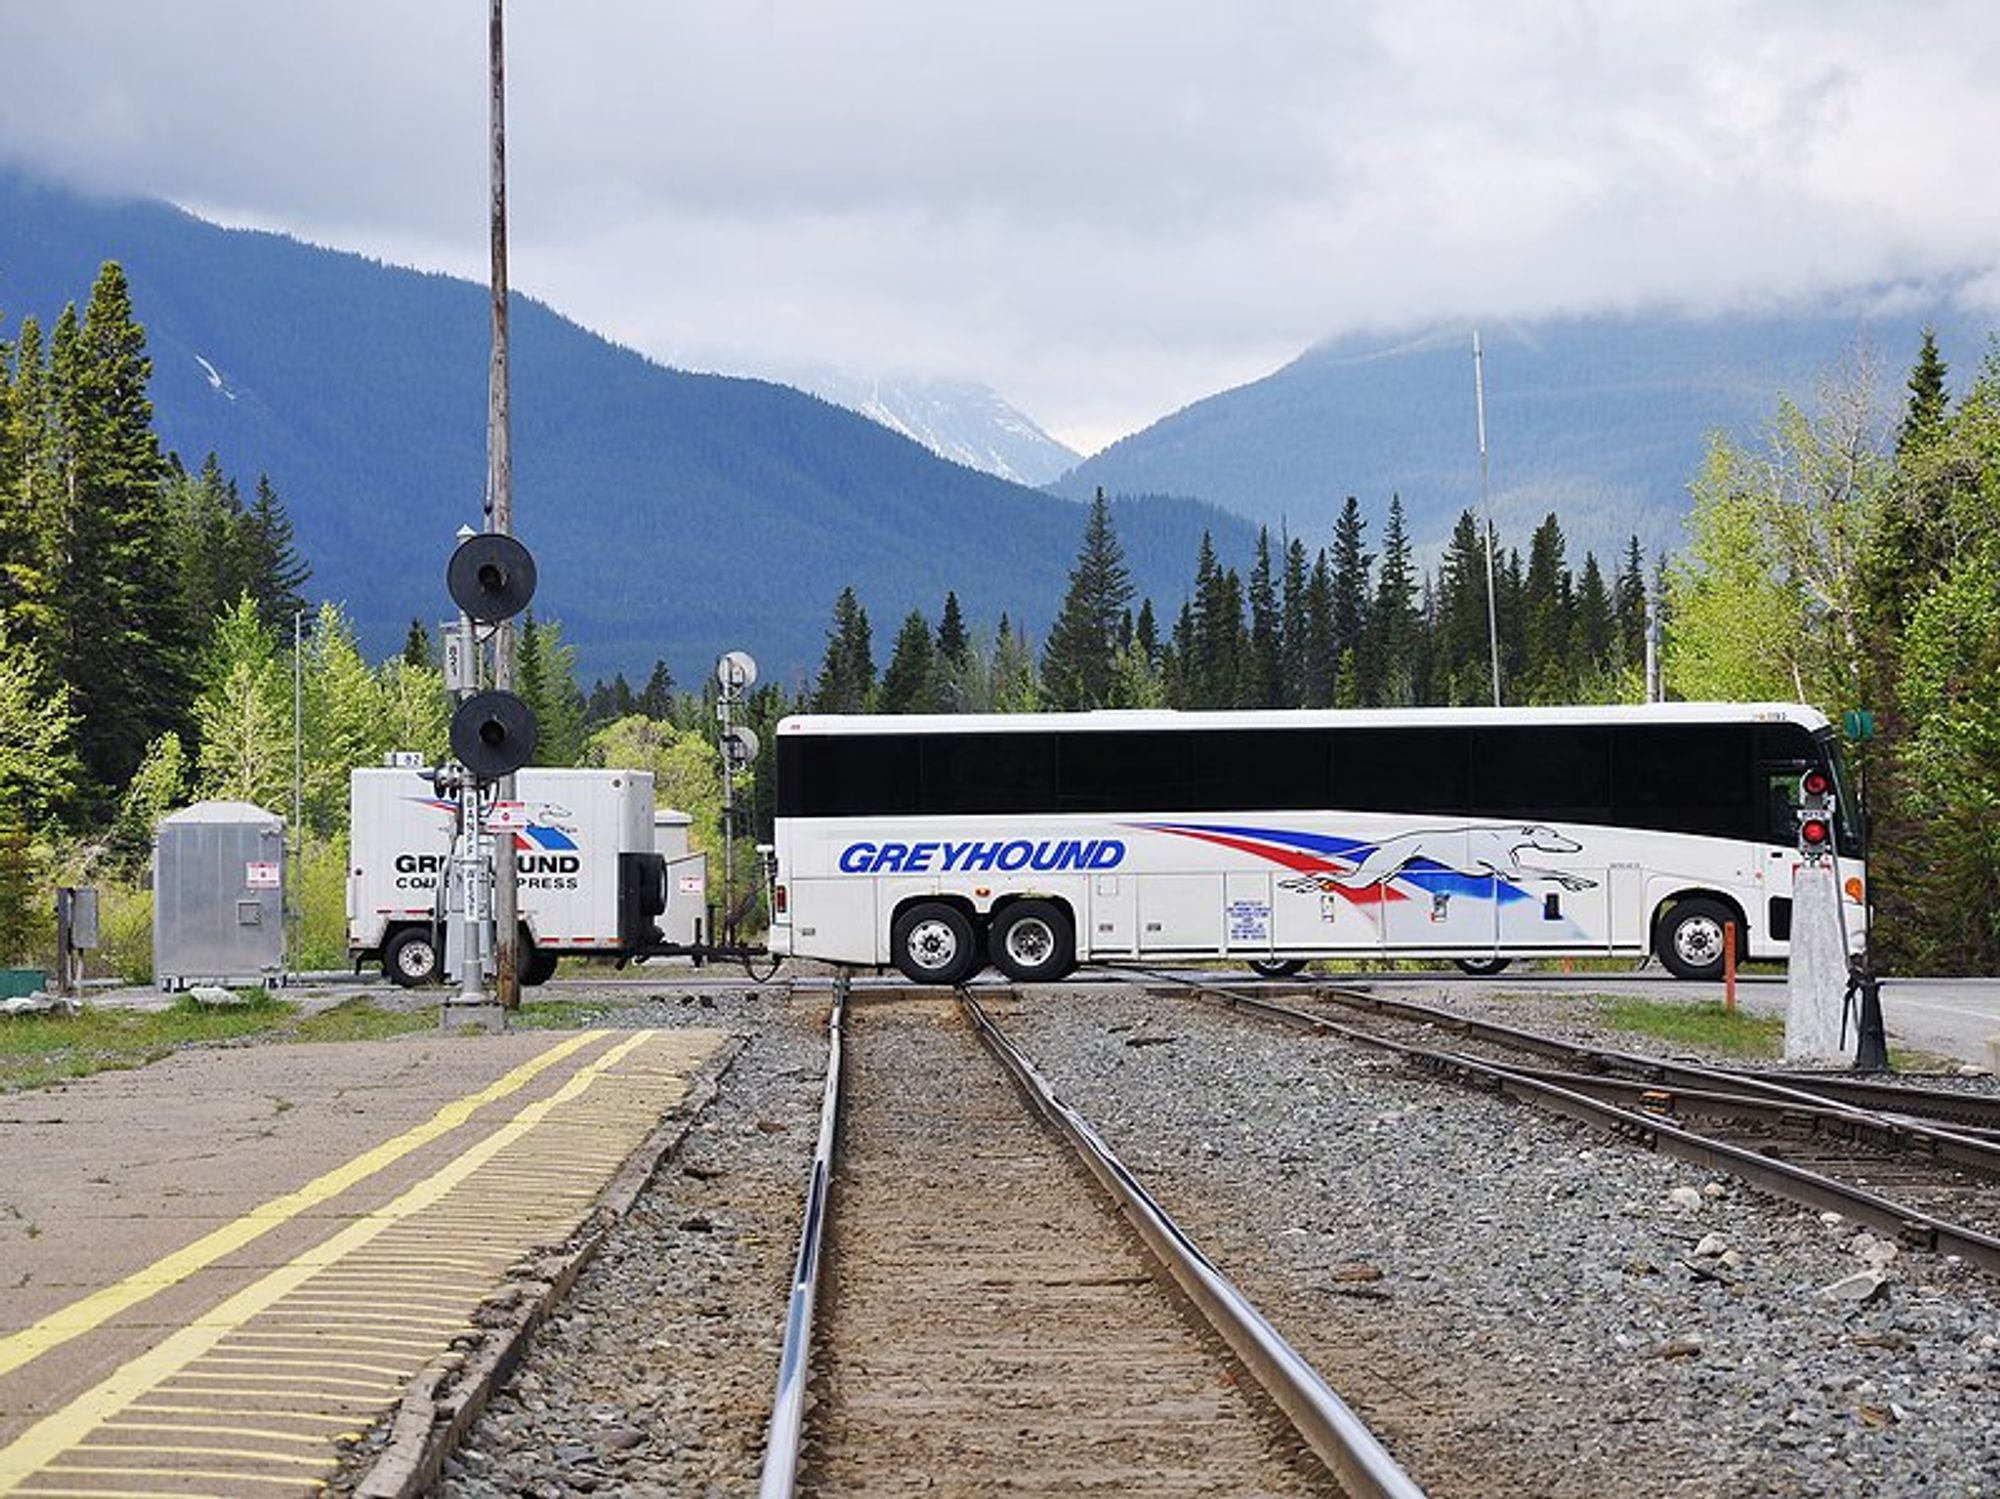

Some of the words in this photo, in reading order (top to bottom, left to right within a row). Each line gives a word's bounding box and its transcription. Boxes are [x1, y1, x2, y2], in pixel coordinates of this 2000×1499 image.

[466, 795, 475, 856] BANFF
[395, 854, 580, 874] GRUND
[839, 839, 1127, 873] GREYHOUND
